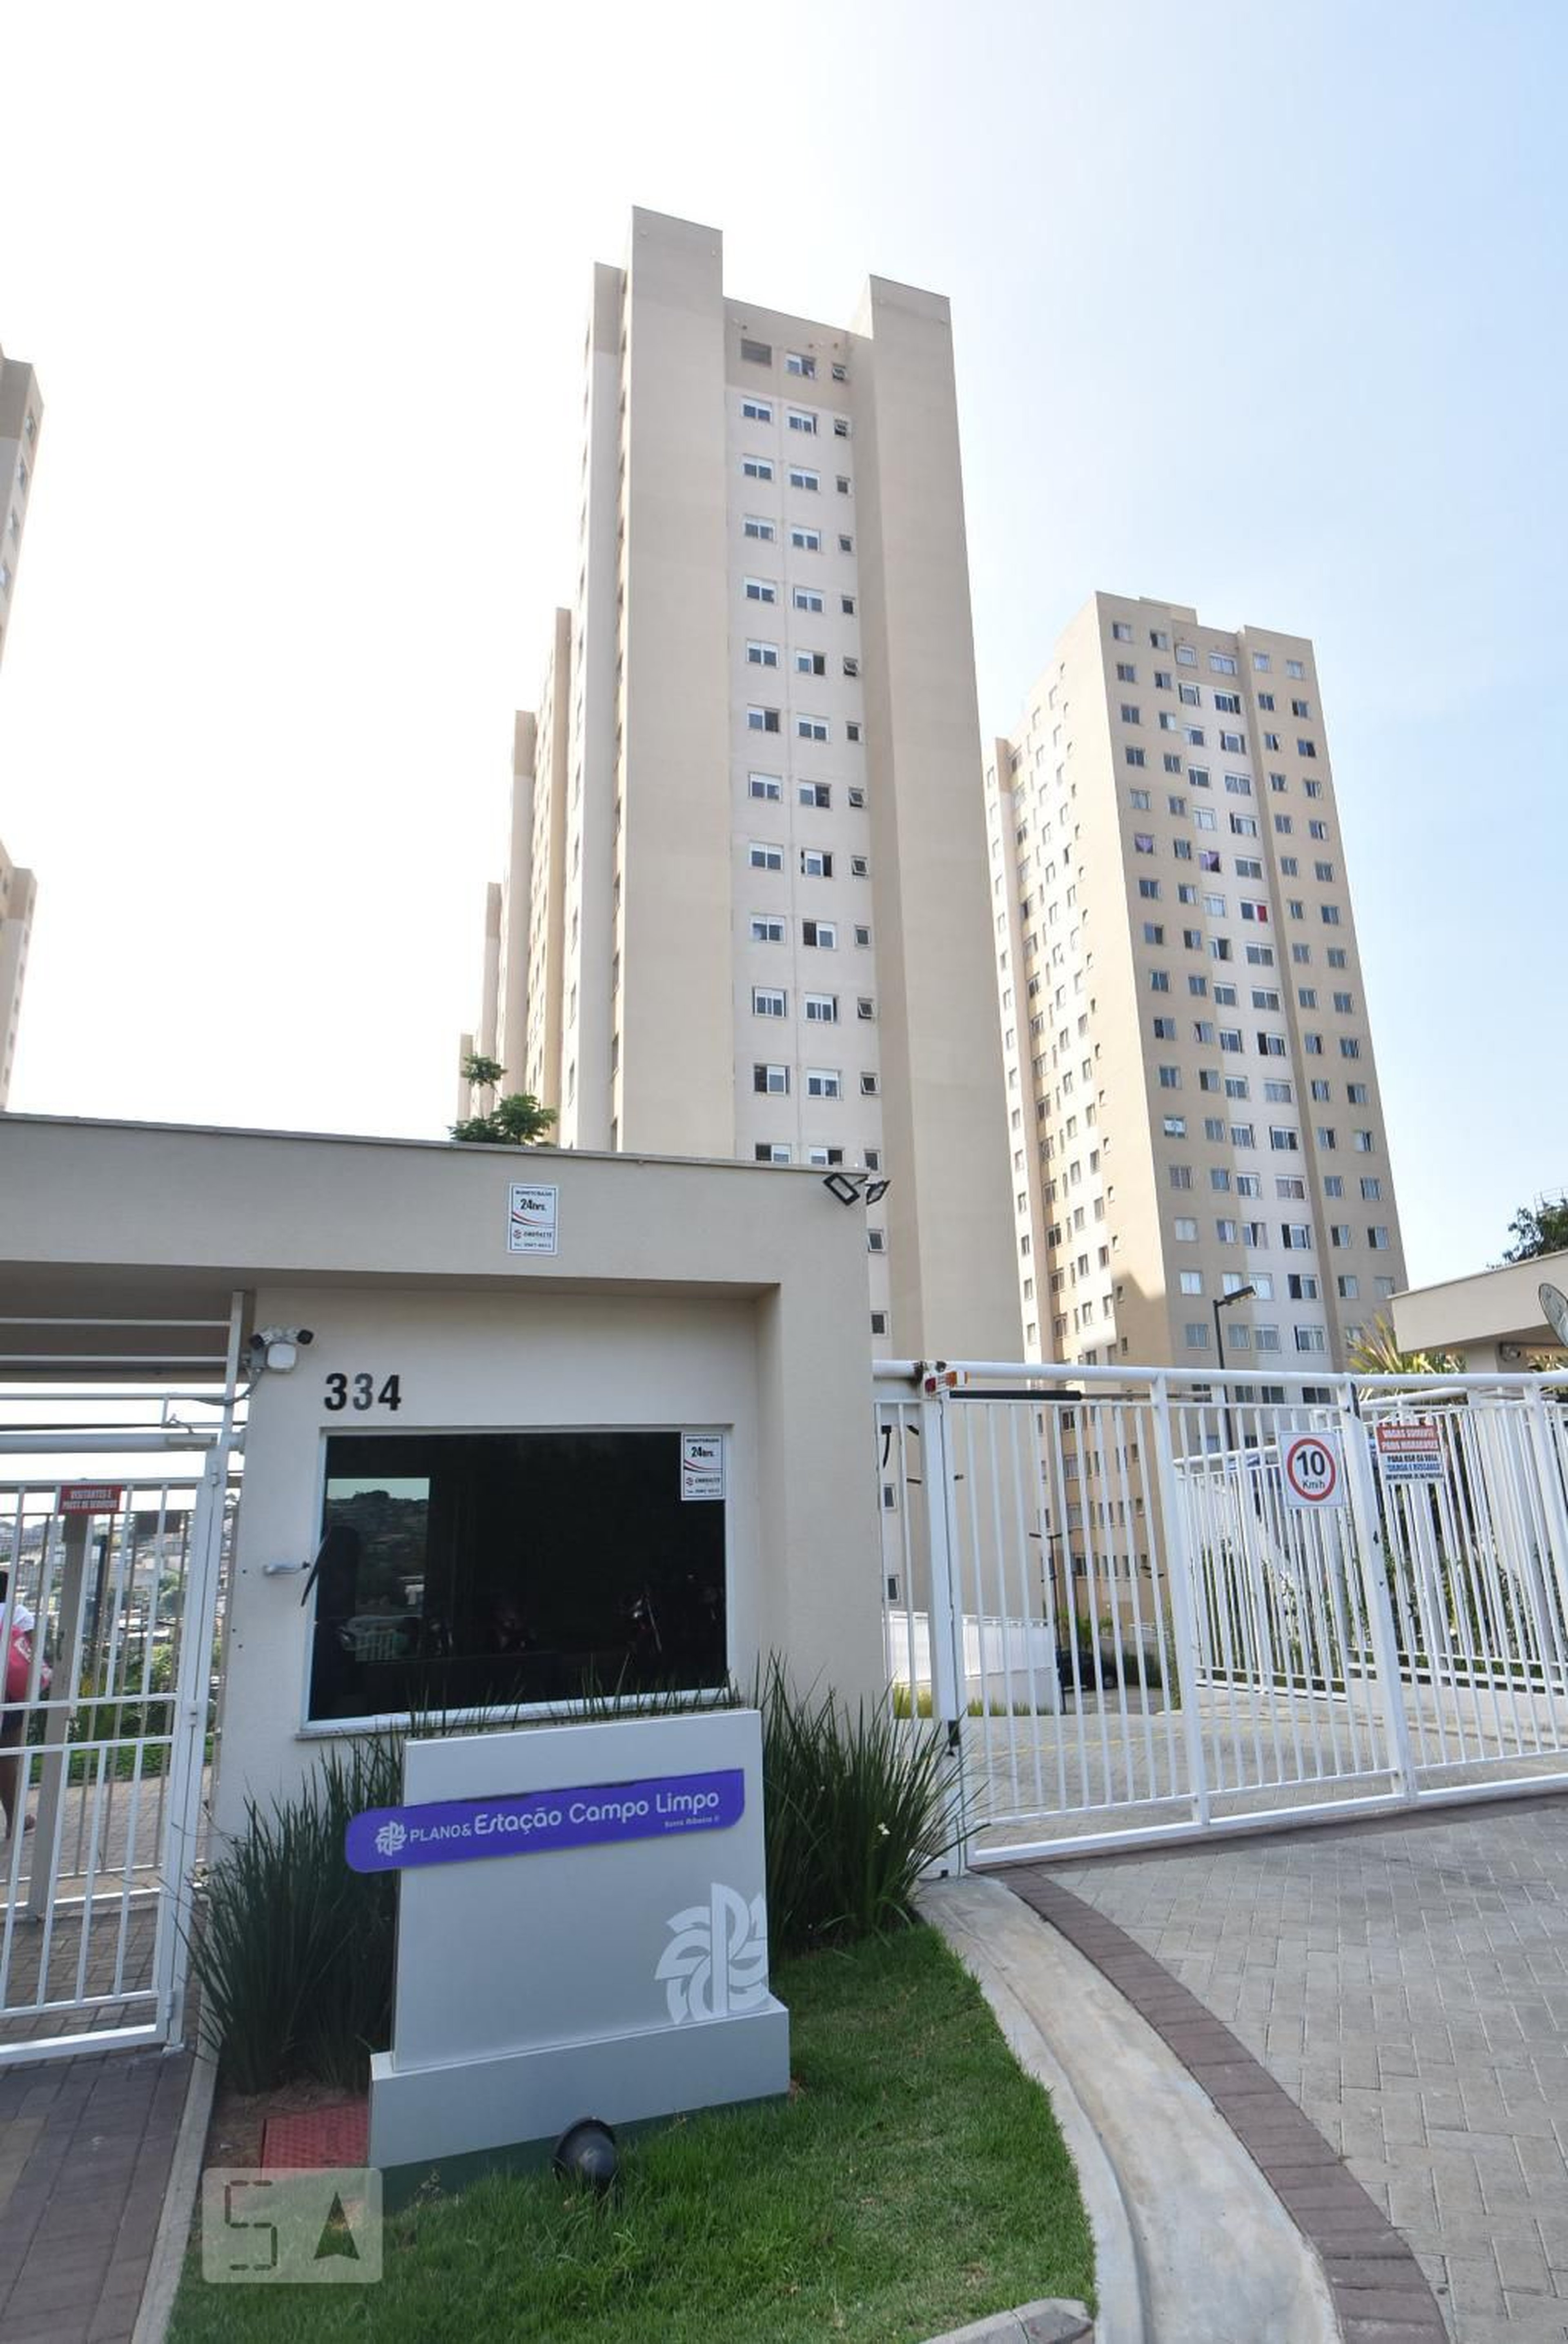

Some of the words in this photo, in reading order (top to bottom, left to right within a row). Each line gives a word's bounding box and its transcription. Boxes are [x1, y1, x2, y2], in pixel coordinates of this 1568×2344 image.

[323, 1372, 402, 1411] 334
[1297, 1450, 1325, 1476] 10
[474, 1807, 562, 1835] Estação
[569, 1800, 649, 1824] Campo
[656, 1792, 719, 1815] Limpo
